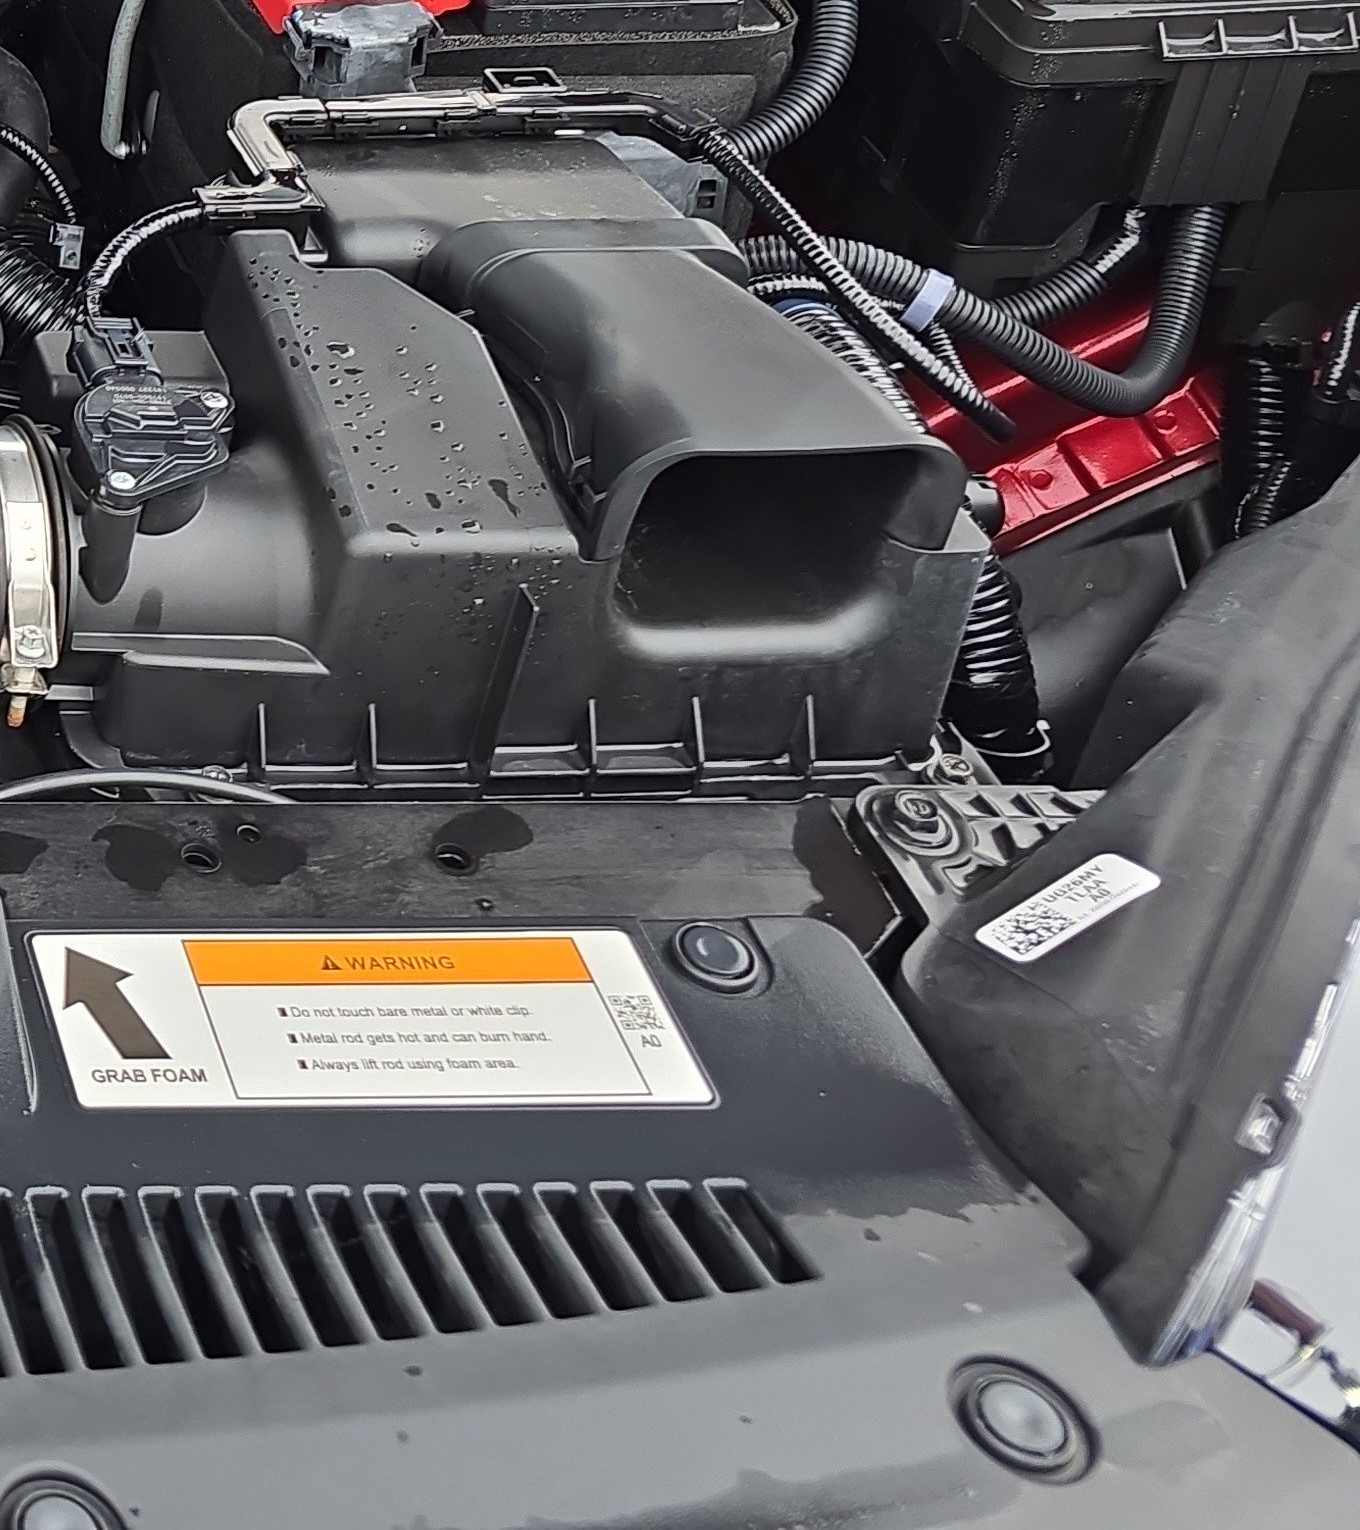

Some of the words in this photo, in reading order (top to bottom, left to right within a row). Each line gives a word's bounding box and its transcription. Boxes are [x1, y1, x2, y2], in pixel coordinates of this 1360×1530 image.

[1042, 864, 1103, 903] UG26MY
[1065, 879, 1107, 902] TLAA
[345, 955, 456, 970] WARNING
[290, 1007, 311, 1018] Do
[313, 1007, 335, 1018] not
[337, 1006, 375, 1018] touch
[379, 1006, 408, 1018] bare
[411, 1005, 448, 1017] metal
[450, 1008, 465, 1017] or
[467, 1005, 503, 1017] white
[506, 1005, 533, 1020] clip.
[300, 1032, 338, 1044] Metal
[341, 1032, 363, 1044] rod
[367, 1033, 395, 1046] gets
[398, 1032, 420, 1043] hot
[423, 1032, 449, 1043] and
[452, 1033, 477, 1043] can
[480, 1032, 510, 1043] burn
[513, 1031, 552, 1042] hand.
[312, 1058, 359, 1072] Always
[361, 1058, 379, 1070] lift
[381, 1058, 404, 1070] rod
[407, 1058, 444, 1071] using
[446, 1057, 482, 1069] foam
[485, 1059, 520, 1069] area.
[91, 1069, 147, 1083] GRAB
[150, 1068, 208, 1082] FOAM
